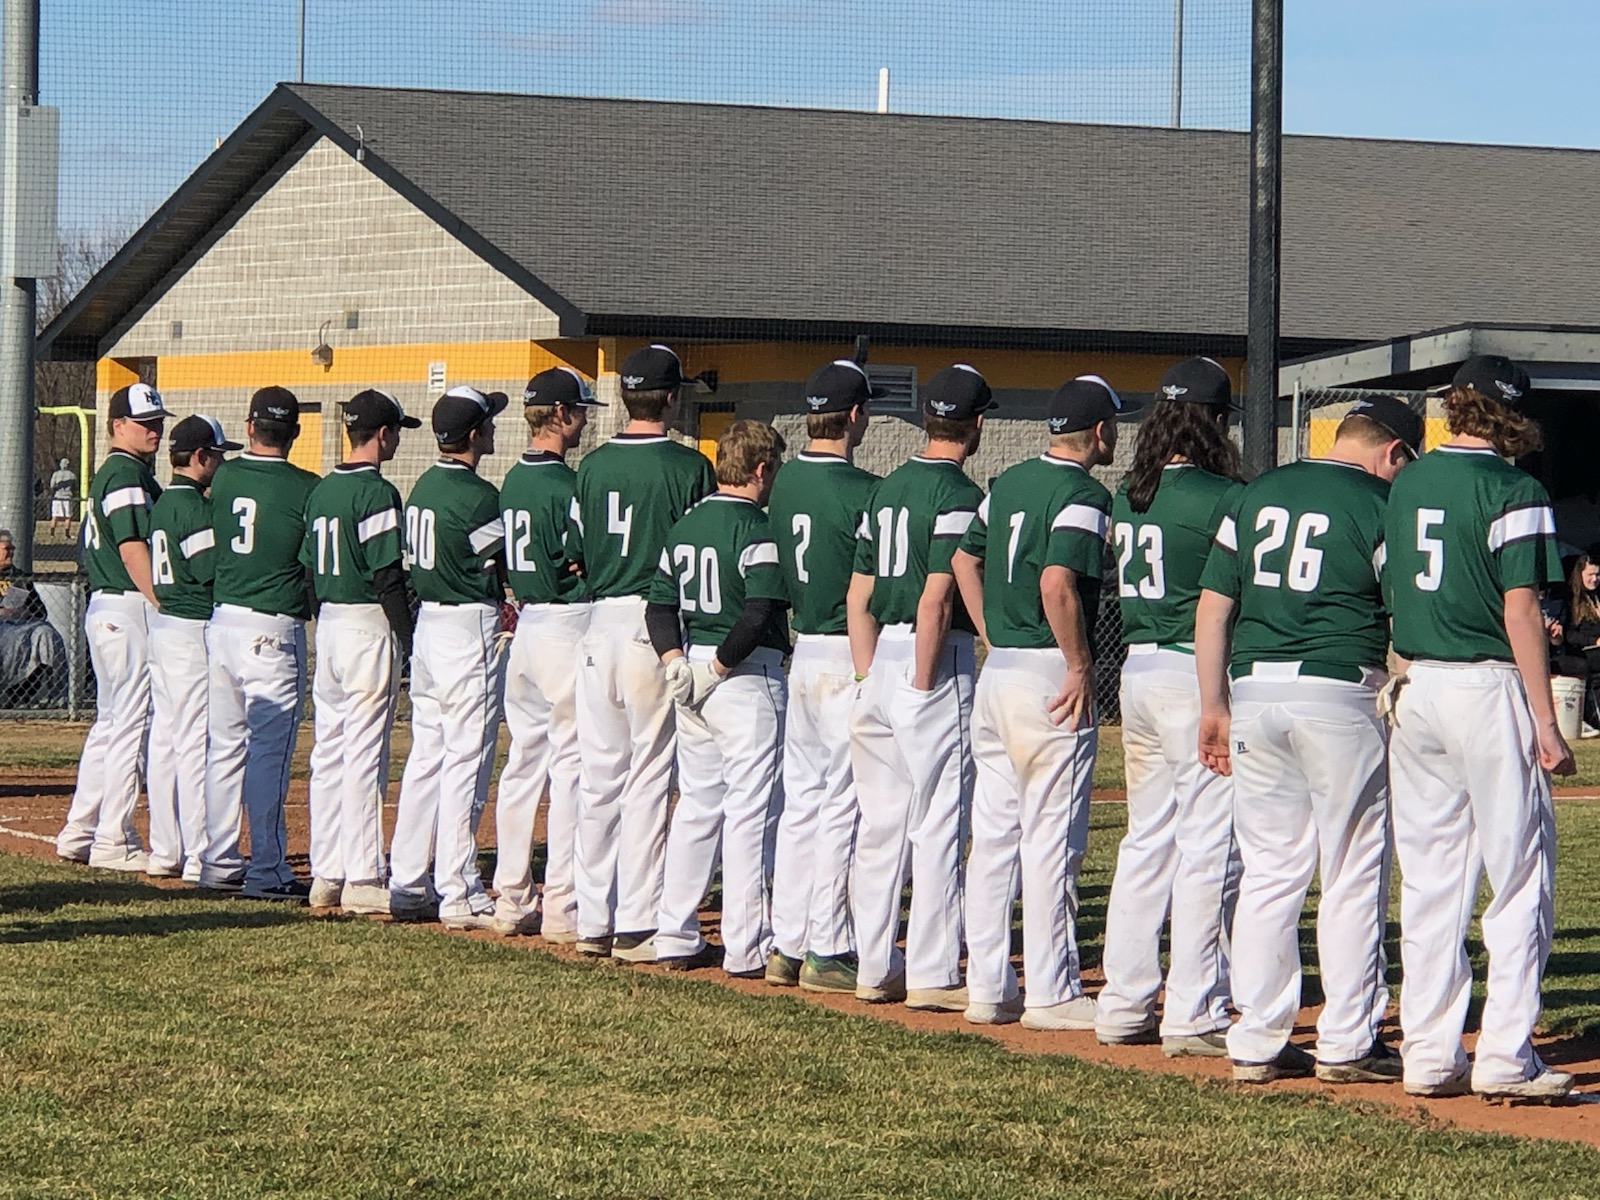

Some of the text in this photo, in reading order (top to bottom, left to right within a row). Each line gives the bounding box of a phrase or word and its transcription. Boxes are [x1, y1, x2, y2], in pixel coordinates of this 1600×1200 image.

[231, 496, 257, 555] 3
[312, 516, 340, 576] 11
[503, 508, 537, 572] 12
[608, 491, 633, 557] 4
[791, 513, 812, 584] 2
[1253, 505, 1330, 592] 26
[1415, 507, 1446, 592] 5
[673, 543, 722, 615] 20
[1114, 521, 1165, 600] 23
